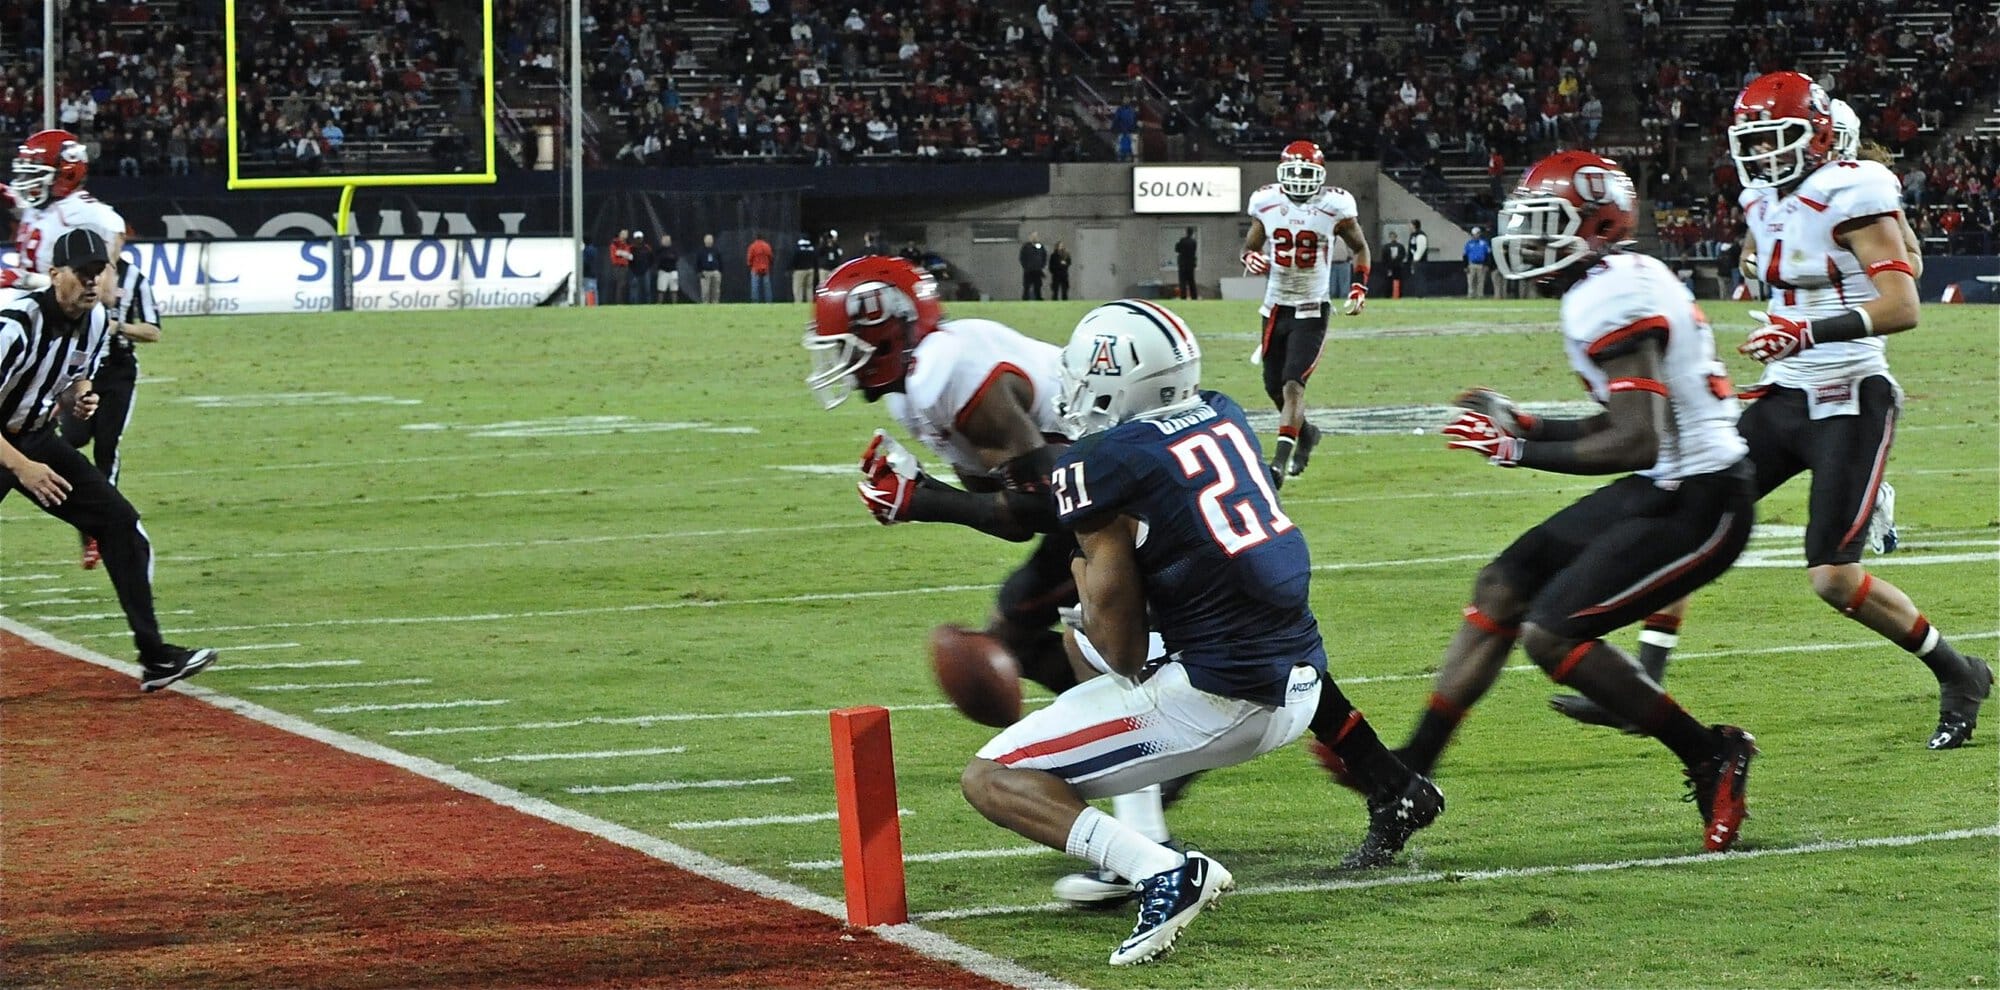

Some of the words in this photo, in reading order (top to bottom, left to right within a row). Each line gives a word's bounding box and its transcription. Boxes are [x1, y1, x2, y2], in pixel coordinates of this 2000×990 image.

[1137, 181, 1204, 197] SOLON
[1272, 227, 1319, 269] 28
[157, 294, 240, 315] olutions
[293, 290, 382, 312] Supior
[388, 289, 438, 310] Solar
[447, 286, 541, 308] Solutions
[1086, 334, 1121, 376] A
[1051, 461, 1093, 516] 21
[1168, 418, 1294, 558] 21
